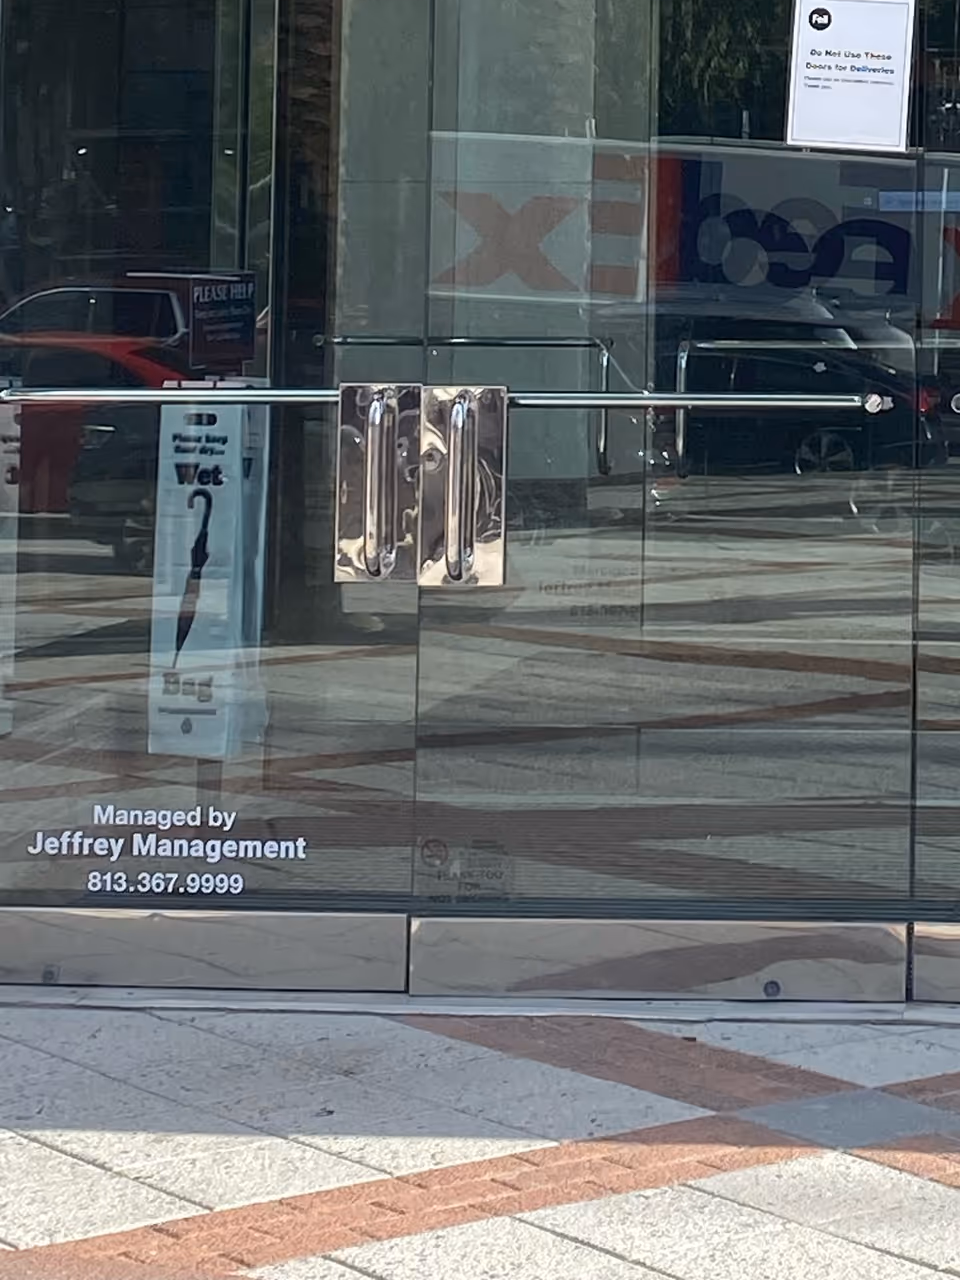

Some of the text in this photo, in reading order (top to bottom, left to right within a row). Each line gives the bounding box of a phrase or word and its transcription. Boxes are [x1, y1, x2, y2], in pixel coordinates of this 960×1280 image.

[809, 48, 892, 61] Do Not Use These
[805, 62, 895, 75] Doors for Deliveries
[193, 282, 254, 303] PLEASE HELP
[174, 463, 224, 486] Wet
[93, 804, 237, 831] Managed by
[27, 831, 307, 863] Jeffrey Management
[87, 871, 244, 895] 813.367.9999
